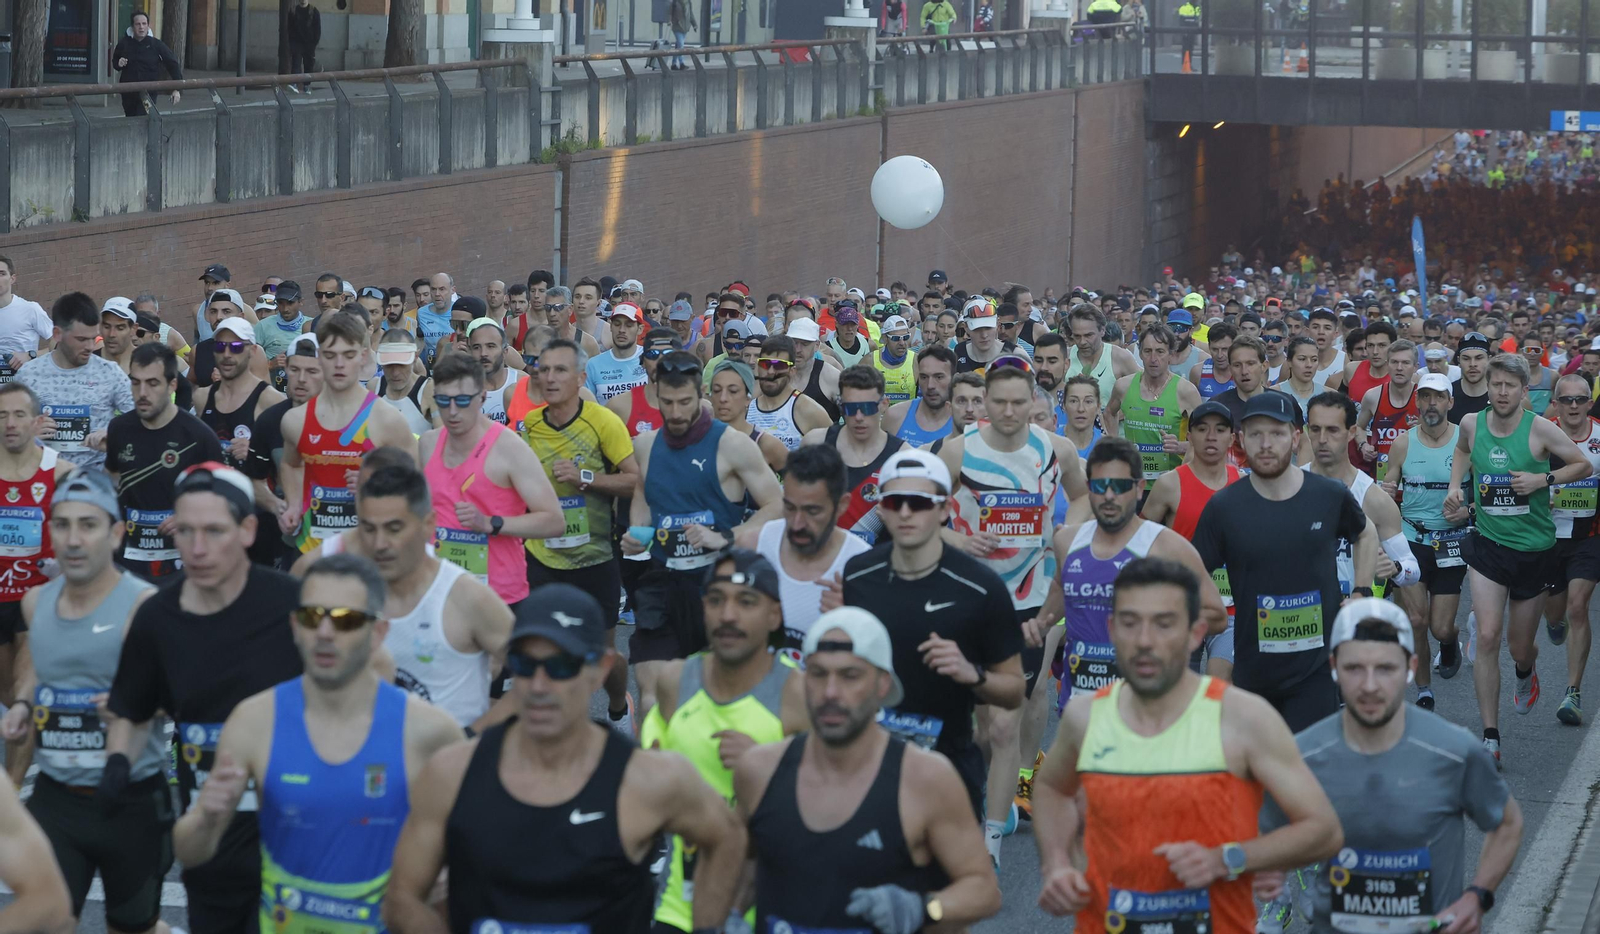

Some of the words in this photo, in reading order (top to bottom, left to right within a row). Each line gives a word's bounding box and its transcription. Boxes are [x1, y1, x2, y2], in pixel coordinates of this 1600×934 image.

[55, 407, 84, 415] ZURICH
[1001, 496, 1036, 505] ZURICH
[1493, 496, 1516, 506] ALEX
[1561, 499, 1590, 508] BYRON
[0, 509, 36, 518] ZURICH
[1002, 512, 1021, 521] 1269
[315, 514, 359, 527] THOMAS
[674, 515, 707, 526] ZURICH
[986, 522, 1035, 535] MORTEN
[449, 531, 481, 542] ZURICH
[138, 538, 164, 549] JUAN
[450, 547, 466, 557] 2234
[1063, 582, 1079, 597] EL
[1279, 595, 1314, 608] ZURICH
[1281, 614, 1301, 624] 1507
[1263, 623, 1318, 639] GASPARD
[1088, 663, 1108, 674] 4233
[41, 731, 104, 749] MORENO
[1363, 854, 1419, 868] ZURICH
[1364, 879, 1397, 893] 3163
[1136, 893, 1198, 912] ZURICH
[1343, 893, 1421, 915] MAXIME
